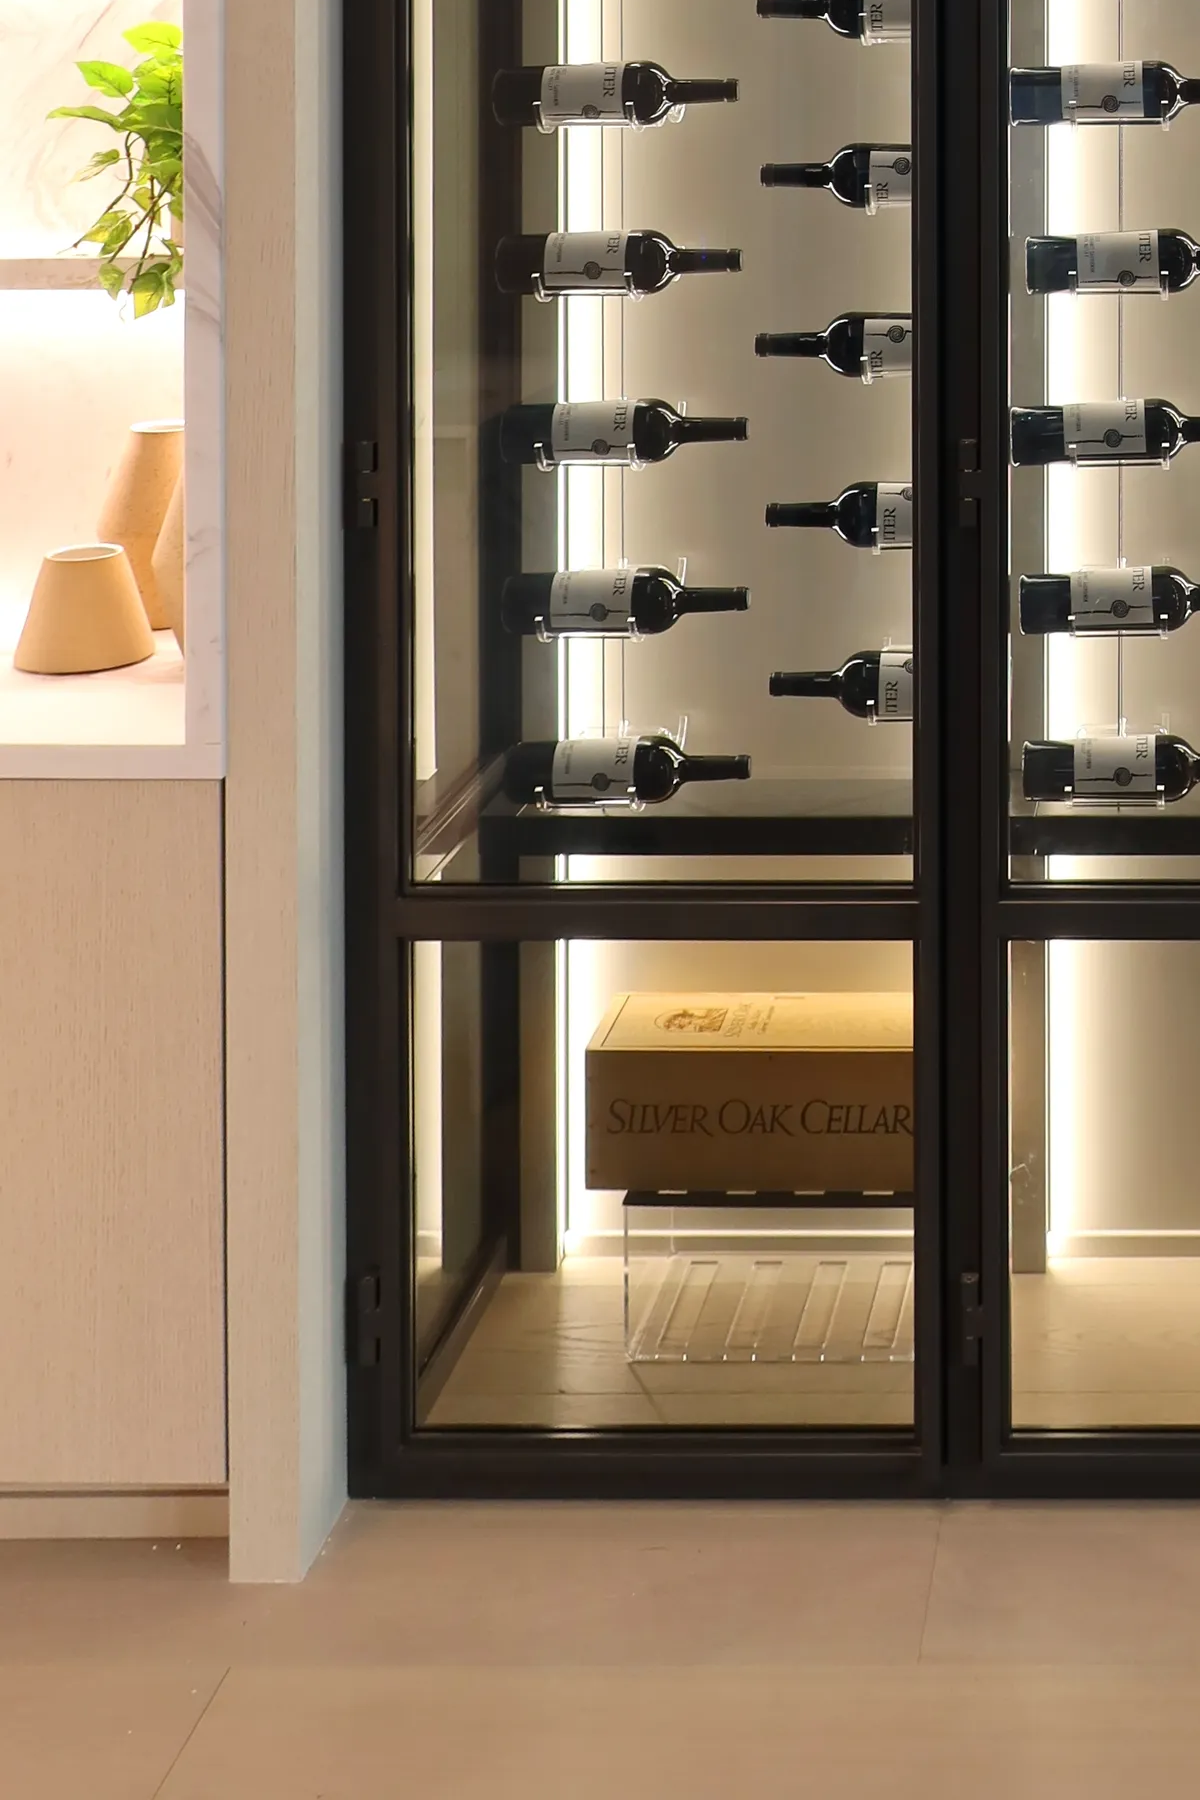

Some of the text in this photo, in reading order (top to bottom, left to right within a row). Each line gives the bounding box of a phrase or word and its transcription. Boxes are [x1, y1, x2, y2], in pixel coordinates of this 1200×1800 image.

[603, 66, 617, 98] ITER
[1139, 233, 1152, 263] ITER
[883, 508, 896, 541] ITER
[885, 681, 898, 713] ITER
[606, 1098, 914, 1137] SILVER OAK CELLAR
